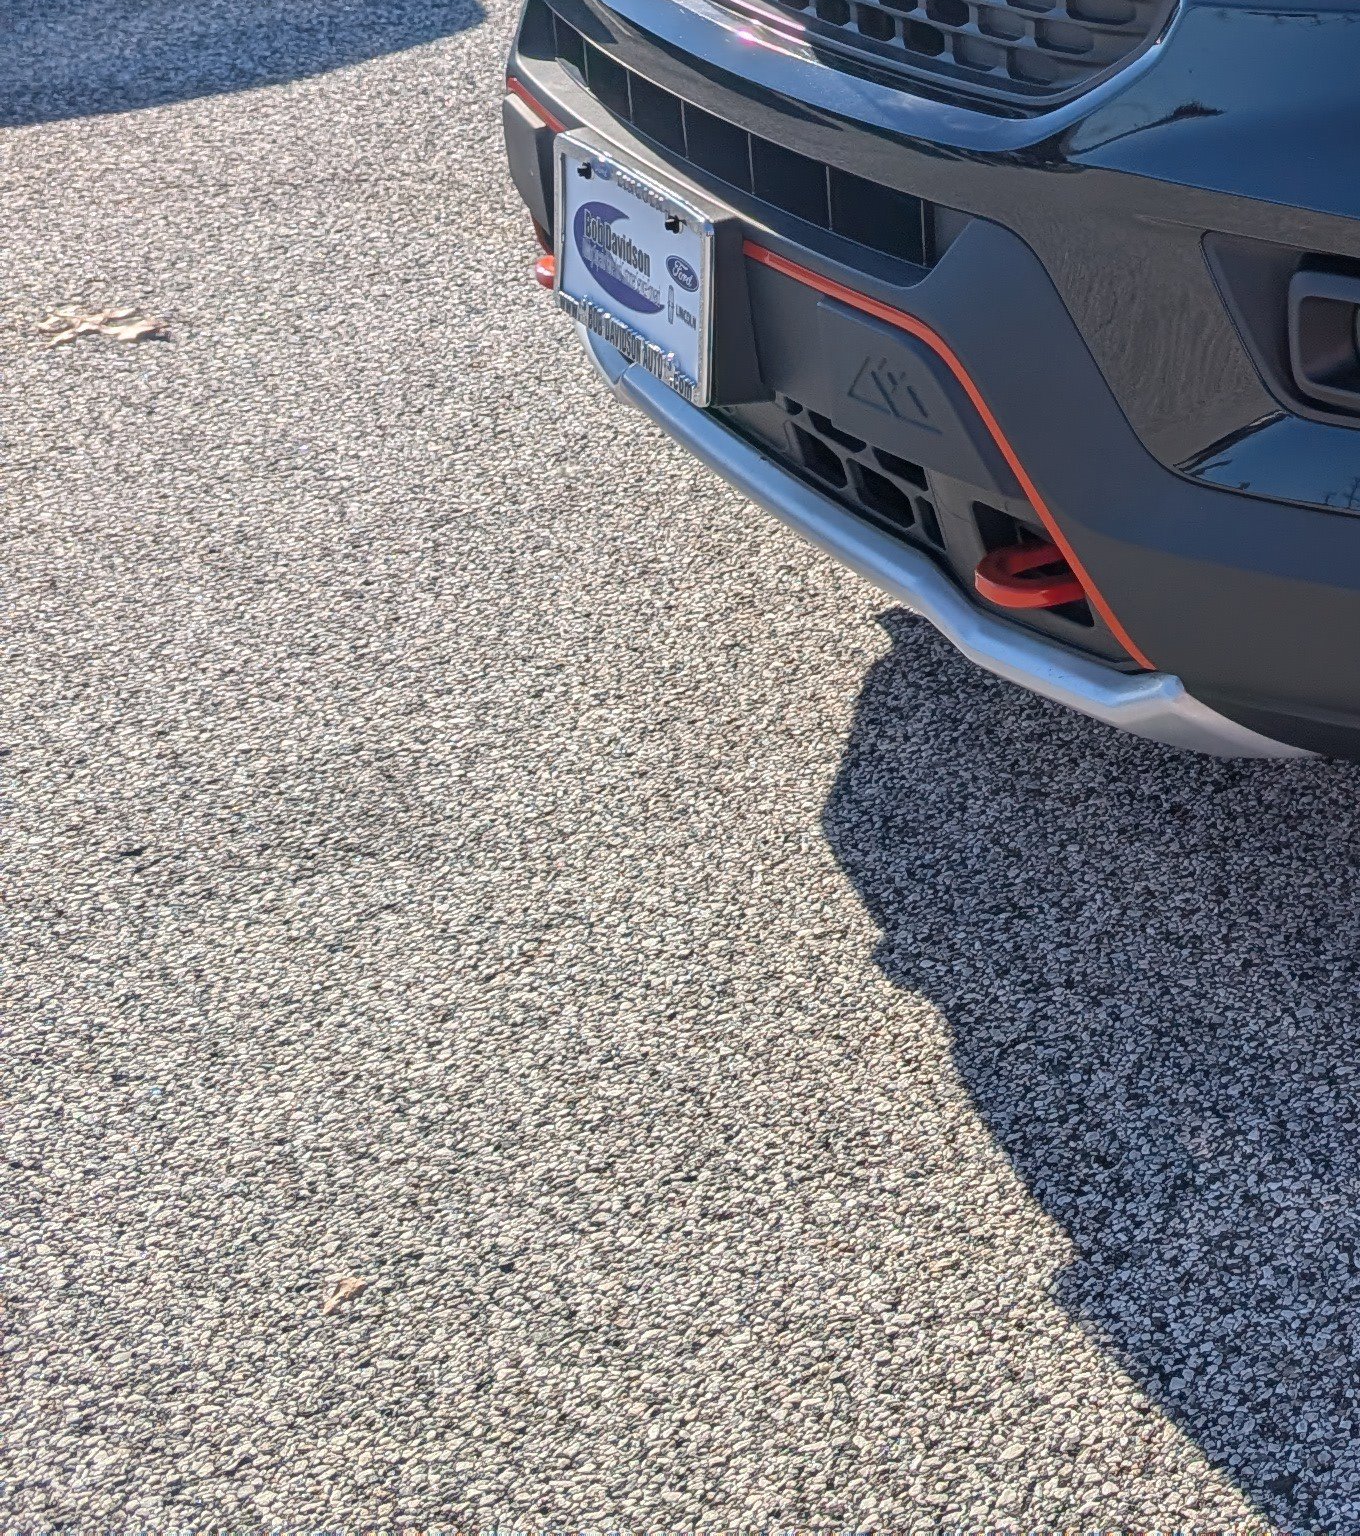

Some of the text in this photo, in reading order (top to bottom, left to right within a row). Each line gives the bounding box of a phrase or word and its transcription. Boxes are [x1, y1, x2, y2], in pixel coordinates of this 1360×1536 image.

[584, 209, 605, 249] Bob
[604, 221, 651, 278] Davidson
[675, 304, 697, 330] LINCOLN
